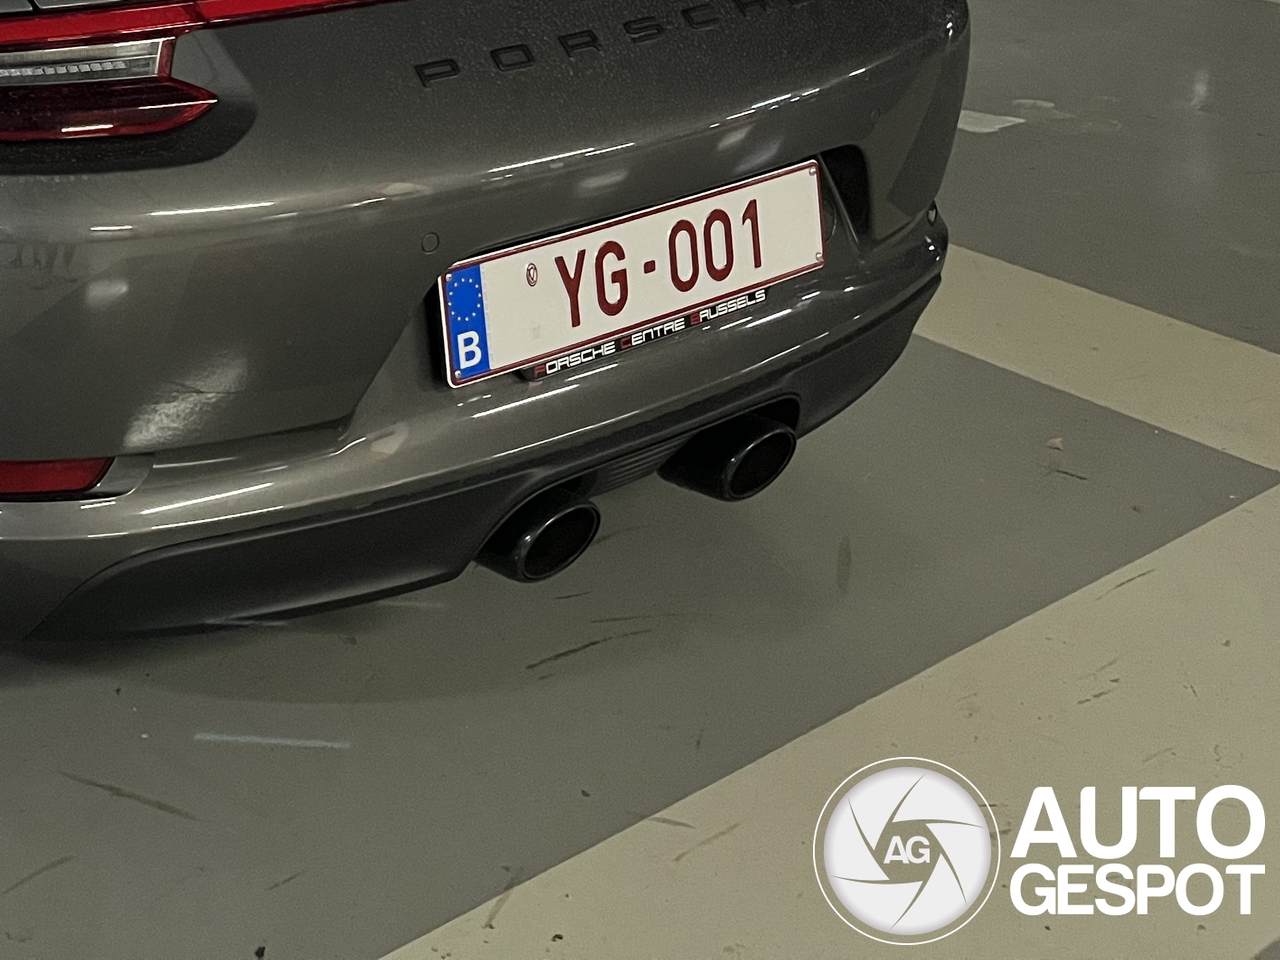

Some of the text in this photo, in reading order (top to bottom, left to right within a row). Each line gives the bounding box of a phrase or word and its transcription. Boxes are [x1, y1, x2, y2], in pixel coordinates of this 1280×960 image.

[554, 198, 763, 329] YG-001
[456, 329, 483, 371] B
[533, 288, 767, 379] PORSCHE CENTRE BRUSSELS
